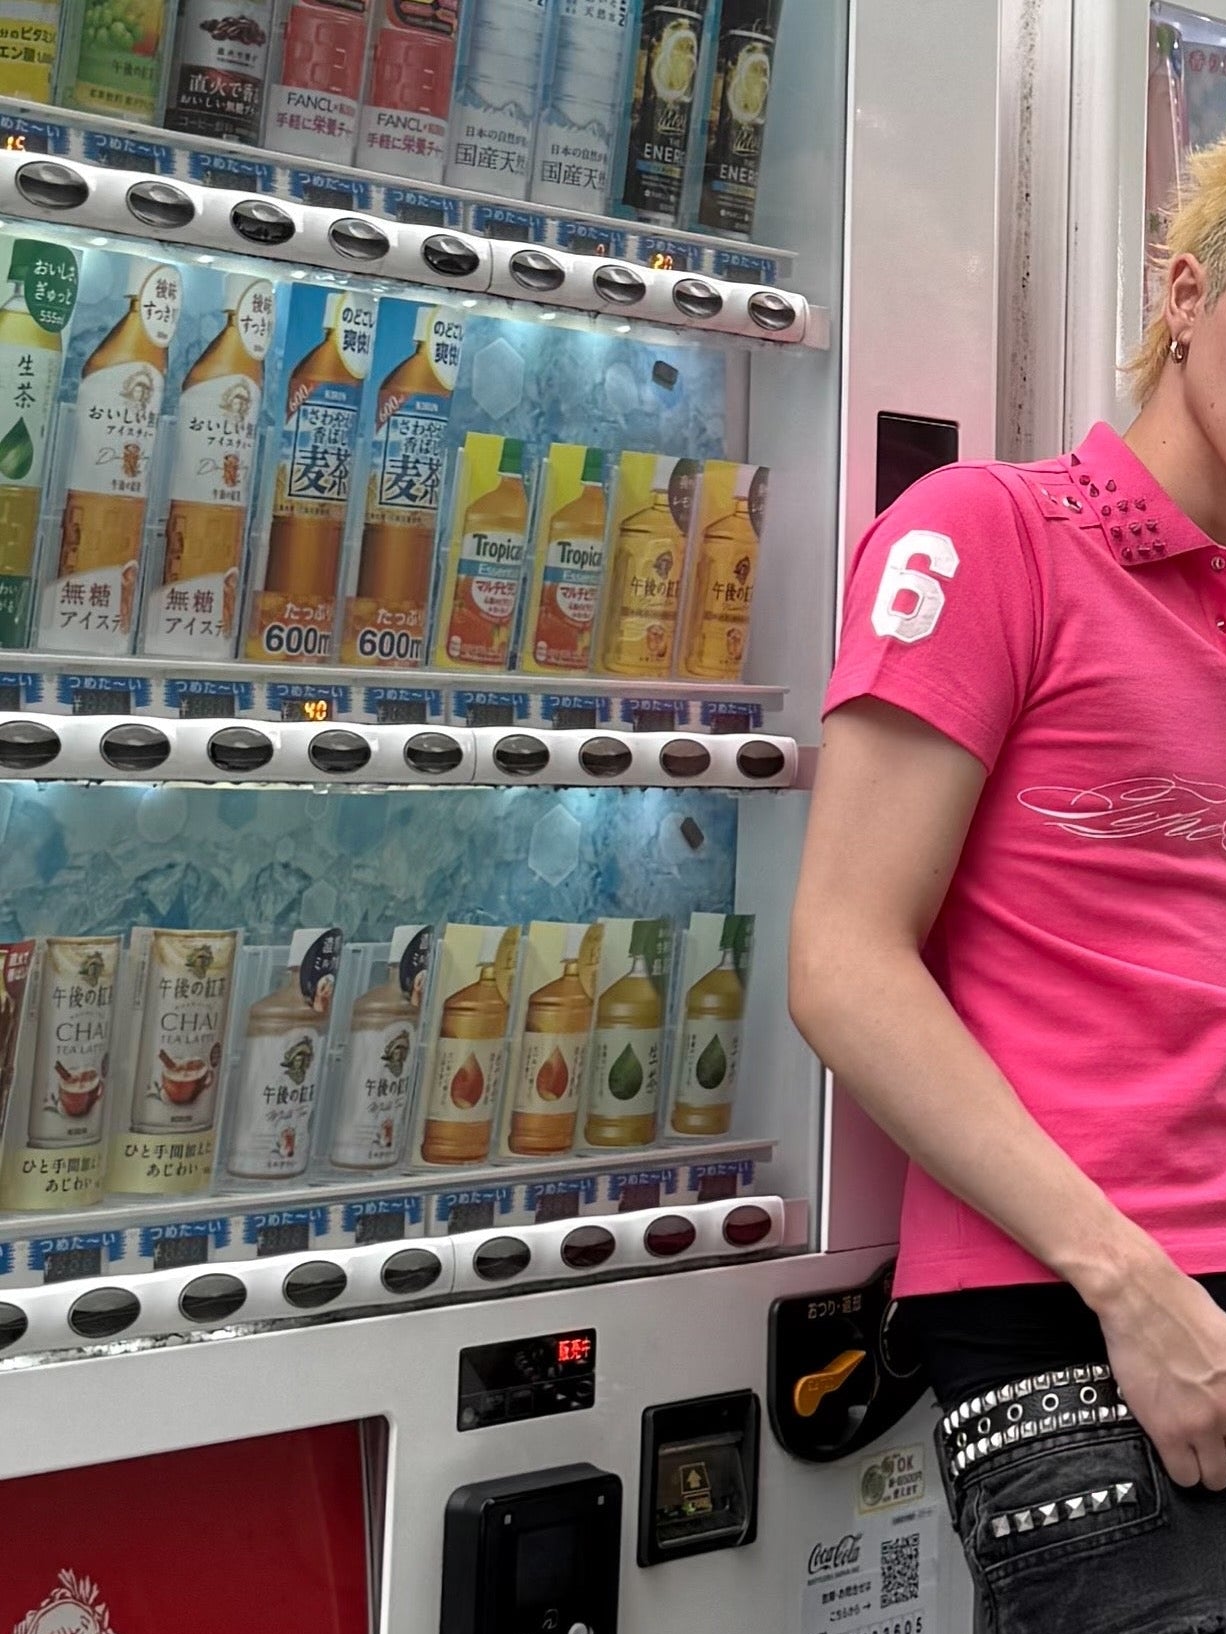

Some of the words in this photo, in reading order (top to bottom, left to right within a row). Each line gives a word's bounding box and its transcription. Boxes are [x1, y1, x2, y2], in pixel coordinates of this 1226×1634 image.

[287, 91, 334, 113] FANCL
[377, 112, 423, 133] FANCL
[13, 354, 36, 409] 生茶
[294, 444, 351, 497] 麦茶
[384, 454, 442, 506] 麦茶
[59, 580, 112, 608] 無糖
[164, 587, 215, 614] 無糖
[870, 529, 961, 645] 6
